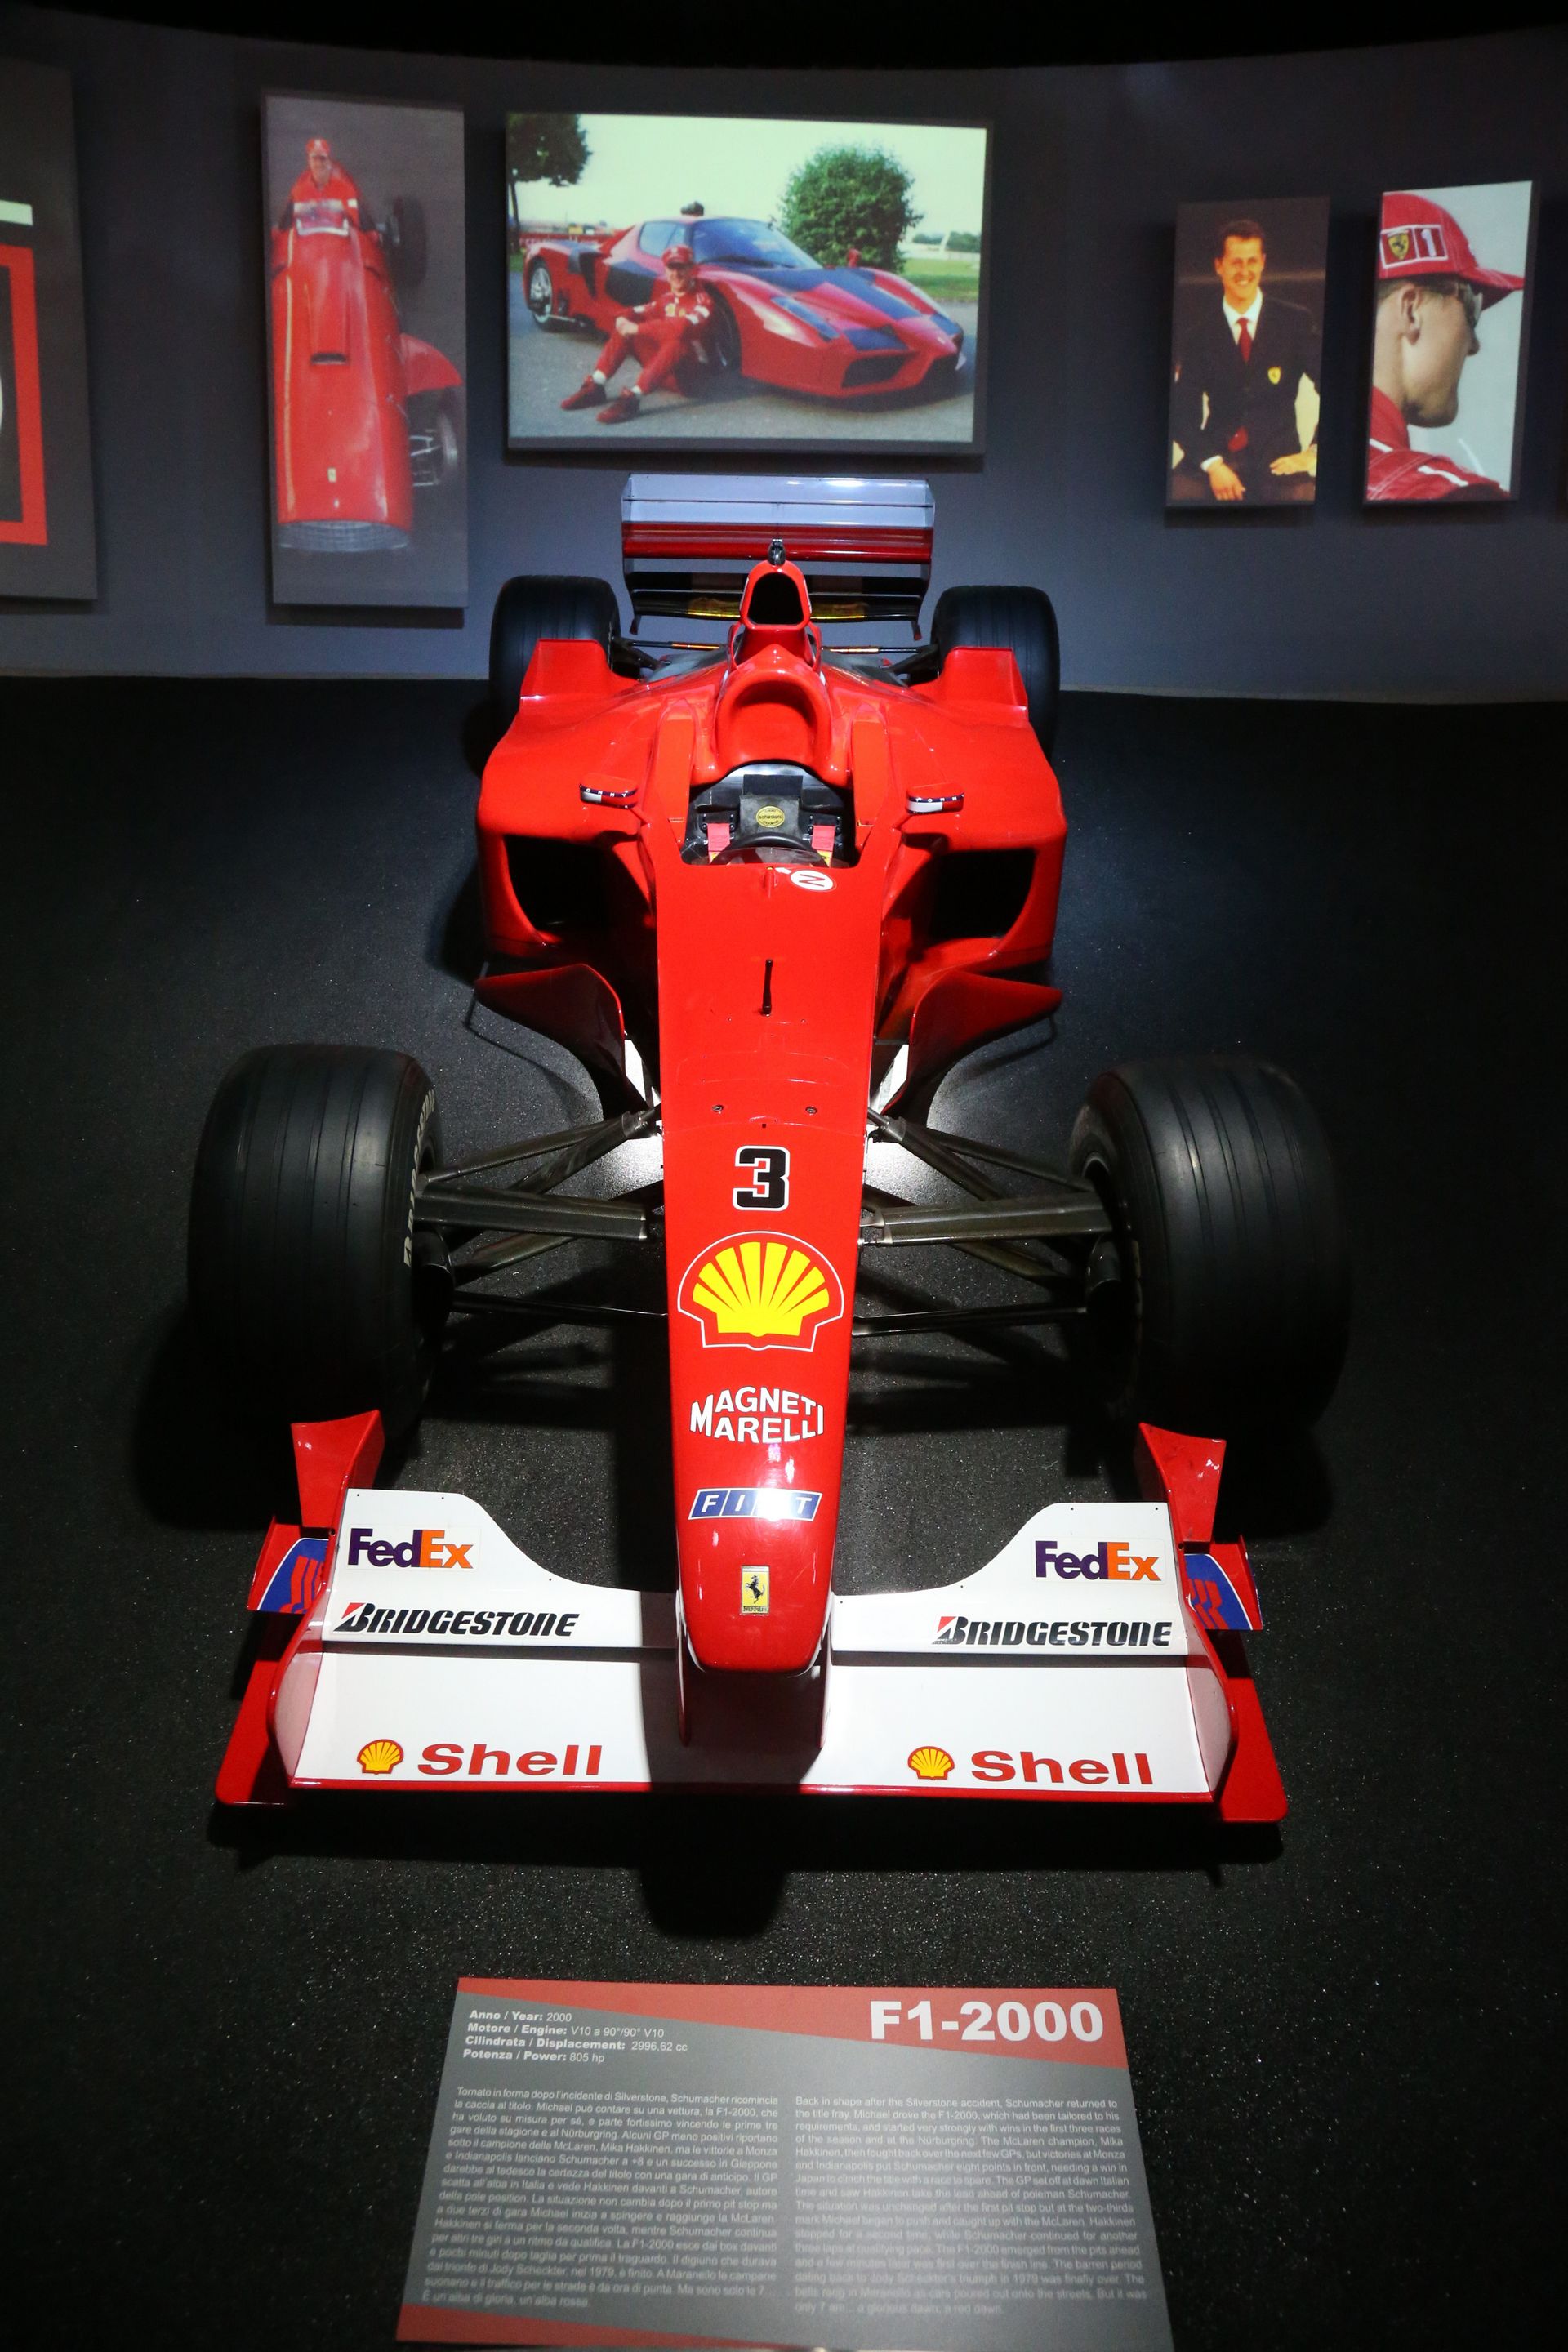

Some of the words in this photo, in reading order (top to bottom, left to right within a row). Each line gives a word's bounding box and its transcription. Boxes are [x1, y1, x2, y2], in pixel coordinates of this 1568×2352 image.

[1421, 229, 1437, 257] 1
[733, 1145, 791, 1211] 3
[690, 1386, 824, 1425] MAGNETI
[690, 1403, 824, 1444] MARELLI
[699, 1493, 815, 1517] FIT
[347, 1528, 474, 1569] FedEx
[1035, 1540, 1161, 1581] FedEx
[332, 1602, 580, 1637] BRIDGESTONE
[931, 1615, 1173, 1646] BRIDGESTONE
[418, 1744, 603, 1775] Shell
[971, 1751, 1152, 1785] Shell
[469, 2010, 501, 2020] Anno
[511, 2011, 543, 2021] Year:
[546, 2012, 572, 2022] 2000
[870, 2001, 1104, 2042] F1-2000
[467, 2022, 511, 2034] Motore
[521, 2025, 568, 2036] Engine:
[571, 2026, 591, 2036] V10
[644, 2029, 665, 2038] V10
[465, 2035, 526, 2047] Cilindrata
[536, 2038, 626, 2050] Displacement:
[631, 2041, 673, 2052] 2996,62
[463, 2048, 513, 2059] Potenza
[523, 2051, 567, 2061] Power:
[569, 2052, 589, 2062] 805
[591, 2053, 605, 2065] hp
[457, 2088, 492, 2097] Tornato
[492, 2089, 502, 2097] in
[502, 2089, 530, 2098] forma
[531, 2090, 555, 2101] dopo
[604, 2092, 613, 2100] di
[614, 2092, 669, 2104] Silverstone,
[670, 2094, 730, 2104] Schumacher
[731, 2096, 778, 2105] ricomincia
[796, 2097, 818, 2105] Back
[822, 2097, 830, 2106] in
[833, 2097, 862, 2109] shape
[865, 2097, 886, 2106] after
[889, 2098, 903, 2106] the
[906, 2098, 958, 2107] Silverstone
[1005, 2099, 1064, 2108] Schumacher
[1067, 2100, 1106, 2109] returned
[1108, 2100, 1118, 2109] to
[465, 2100, 497, 2109] caccia
[497, 2101, 507, 2110] al
[536, 2102, 573, 2112] Michael
[574, 2104, 593, 2114] può
[595, 2105, 630, 2114] contare
[716, 2108, 759, 2118] F1-2000,
[761, 2109, 778, 2118] che
[795, 2109, 810, 2118] the
[813, 2109, 829, 2118] title
[854, 2109, 890, 2118] Michael
[892, 2109, 919, 2118] drove
[920, 2110, 936, 2118] the
[938, 2110, 980, 2120] F1-2000,
[982, 2110, 1009, 2119] which
[1012, 2111, 1030, 2119] had
[1031, 2111, 1056, 2120] been
[1058, 2111, 1093, 2120] tailored
[1104, 2112, 1120, 2121] his
[452, 2112, 465, 2121] ha
[467, 2112, 497, 2122] voluto
[515, 2114, 548, 2123] misura
[550, 2118, 567, 2127] per
[598, 2118, 623, 2128] parte
[626, 2118, 673, 2127] fortissimo
[676, 2118, 719, 2129] vincendo
[722, 2120, 731, 2129] le
[734, 2121, 761, 2132] prime
[765, 2123, 778, 2131] tre
[862, 2122, 880, 2131] and
[882, 2123, 915, 2132] started
[917, 2125, 937, 2134] very
[939, 2123, 977, 2134] strongly
[978, 2123, 998, 2132] with
[999, 2123, 1021, 2132] wins
[1022, 2123, 1031, 2132] in
[1032, 2123, 1049, 2132] the
[1049, 2123, 1067, 2132] first
[1068, 2123, 1094, 2132] three
[449, 2127, 472, 2136] gare
[474, 2125, 497, 2135] della
[498, 2126, 540, 2138] stagione
[550, 2127, 559, 2136] al
[621, 2130, 652, 2140] Alcuni
[653, 2131, 669, 2140] GP
[700, 2132, 733, 2144] positivi
[736, 2133, 777, 2145] riportano
[795, 2134, 804, 2143] of
[808, 2134, 823, 2143] the
[865, 2135, 883, 2144] and
[887, 2136, 896, 2144] at
[899, 2135, 915, 2144] the
[980, 2136, 1000, 2145] The
[1003, 2136, 1045, 2145] McLaren
[1047, 2136, 1098, 2148] champion,
[1100, 2137, 1124, 2145] Mika
[448, 2139, 472, 2147] sotto
[473, 2139, 479, 2148] il
[479, 2139, 528, 2151] campione
[528, 2140, 552, 2149] della
[554, 2140, 599, 2152] McLaren,
[600, 2142, 624, 2152] Mika
[693, 2145, 702, 2154] le
[703, 2145, 735, 2154] vittorie
[746, 2146, 777, 2156] Monza
[982, 2149, 1000, 2158] few
[1026, 2149, 1041, 2158] but
[1041, 2149, 1081, 2158] victories
[1093, 2150, 1125, 2159] Monza
